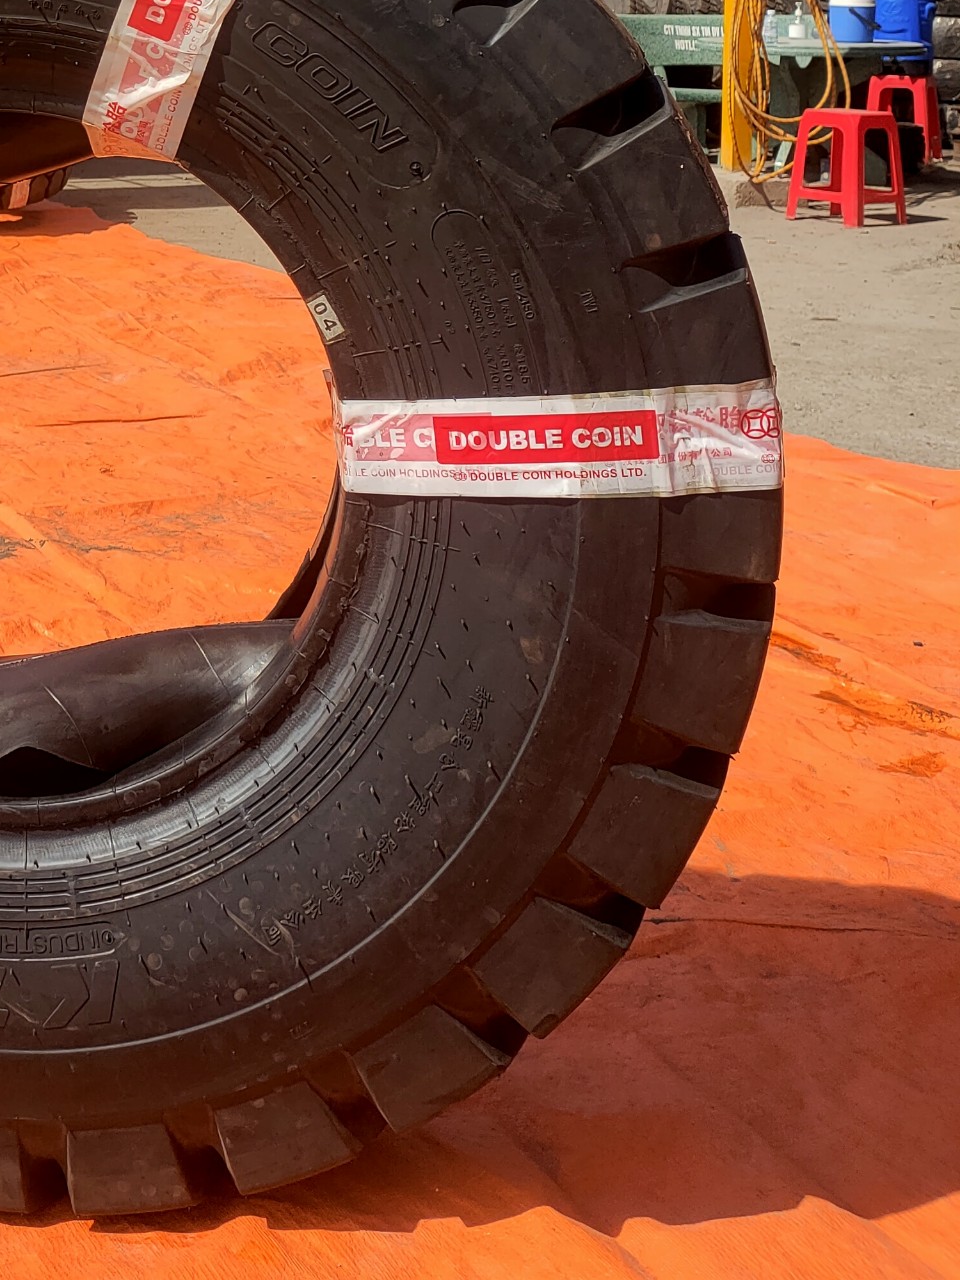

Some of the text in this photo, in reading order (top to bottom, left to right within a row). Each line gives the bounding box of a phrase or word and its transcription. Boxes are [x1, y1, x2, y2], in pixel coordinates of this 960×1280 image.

[251, 22, 409, 152] COIN
[449, 429, 563, 451] DOUBLE
[572, 425, 644, 449] COIN
[470, 468, 647, 482] DOUBLE COIN HOLDINGS LTD.
